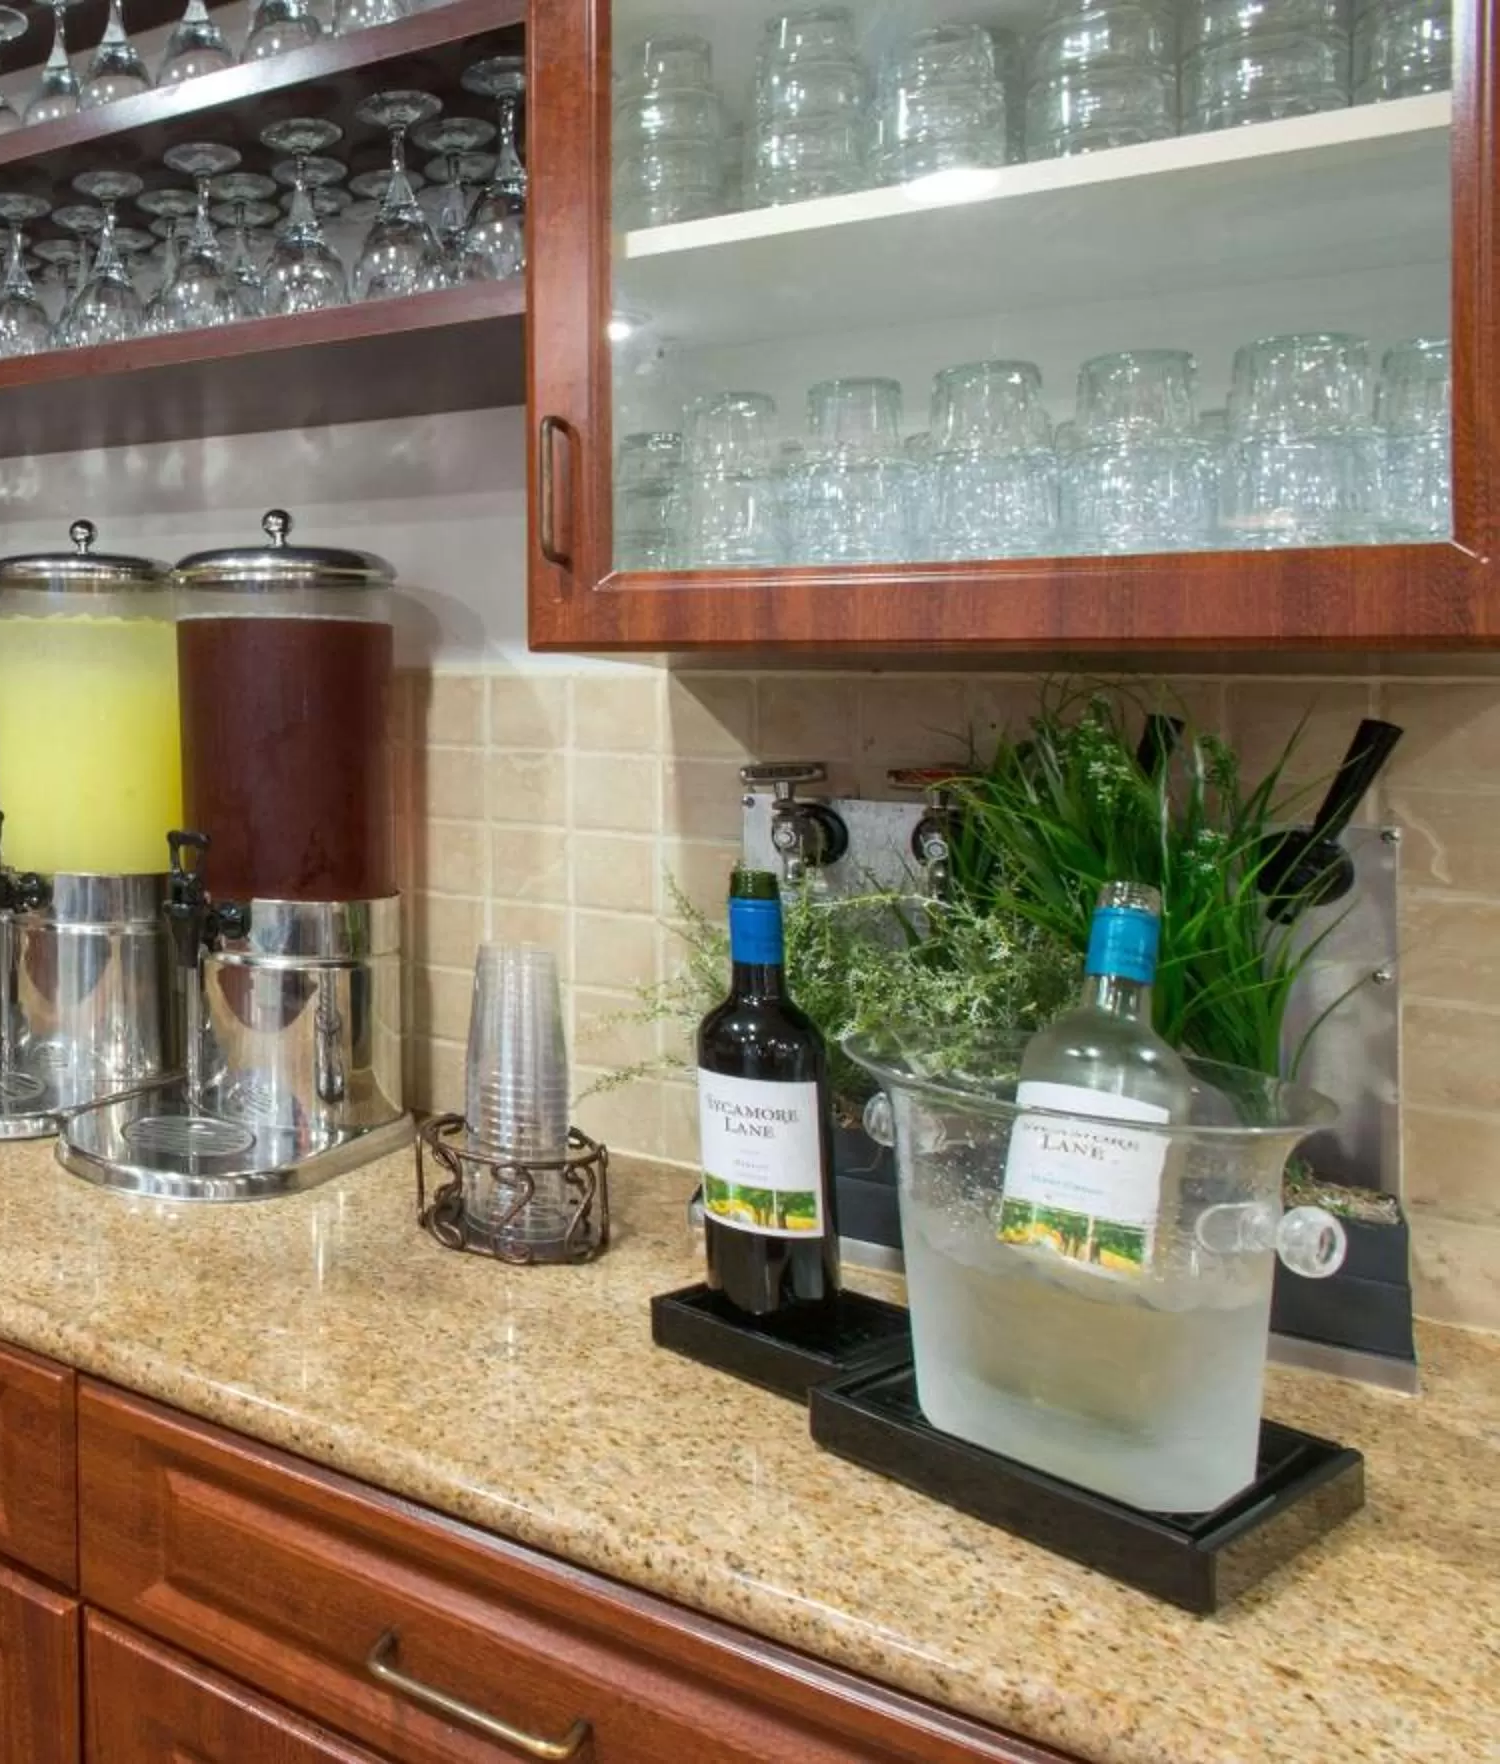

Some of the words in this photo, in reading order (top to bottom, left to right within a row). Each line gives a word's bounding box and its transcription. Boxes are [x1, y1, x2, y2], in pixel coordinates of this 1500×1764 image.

[706, 1093, 799, 1124] SYCAMORE
[725, 1116, 775, 1138] LANE
[1042, 1133, 1104, 1160] LANE
